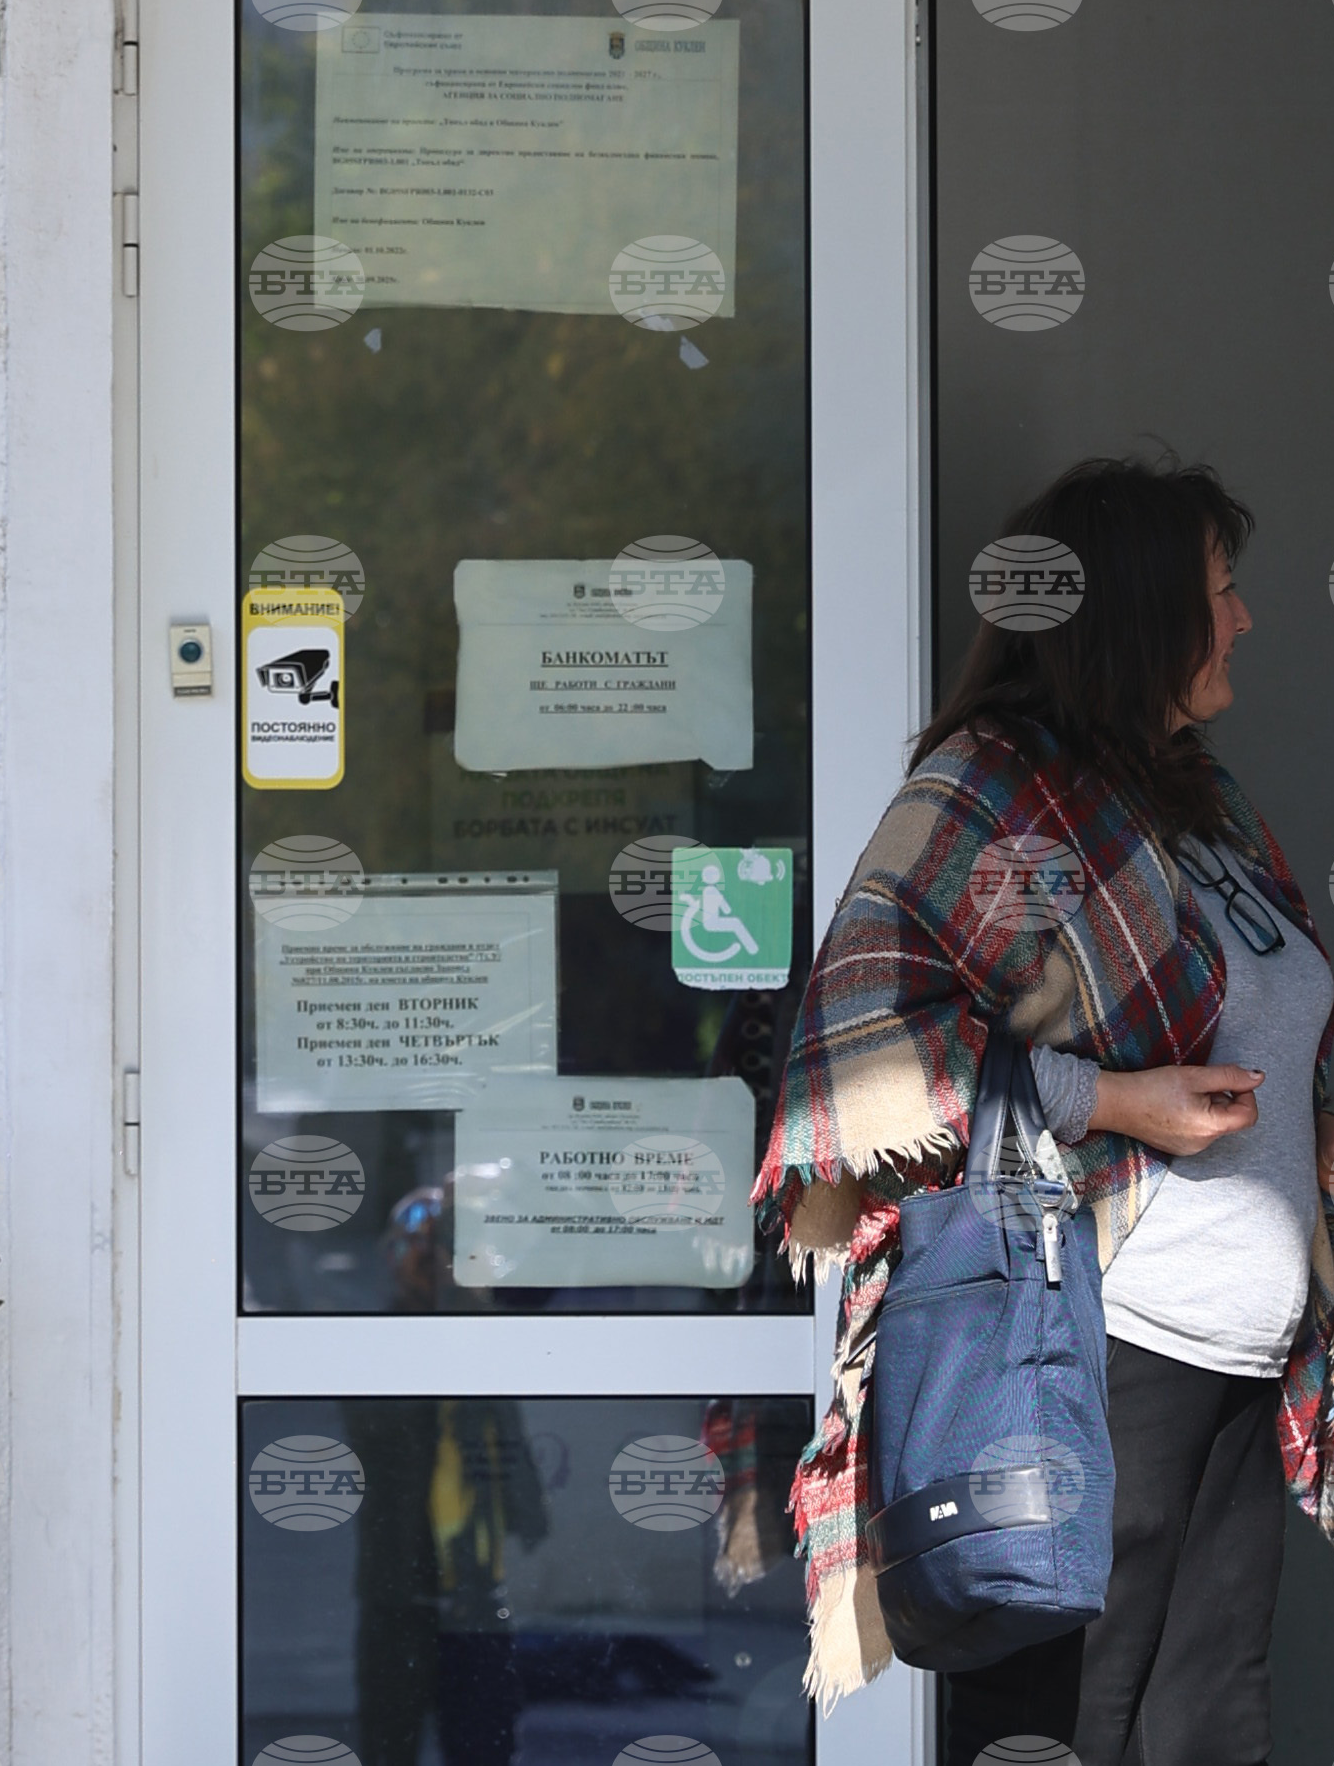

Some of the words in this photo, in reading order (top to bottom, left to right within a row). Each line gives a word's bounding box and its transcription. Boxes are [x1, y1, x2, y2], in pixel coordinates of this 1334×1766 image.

[541, 651, 669, 665] БАНКОМАТЪТ
[617, 681, 676, 690] ГРАЖДАНИ
[251, 722, 337, 734] ПОСТОЯННО
[297, 1000, 361, 1015] Приемен
[365, 1001, 390, 1013] ден
[398, 997, 479, 1011] ВТОРНИК
[316, 1020, 332, 1031] от
[336, 1017, 380, 1031] 8:30ч.
[383, 1020, 399, 1031] до
[297, 1037, 361, 1052] Приемен
[365, 1038, 390, 1050] ден
[398, 1034, 500, 1048] ЧЕТВЪРТЪК
[317, 1057, 332, 1068] от
[391, 1056, 408, 1068] до
[539, 1152, 625, 1166] РАБОТНО
[635, 1152, 696, 1166] ВРЕМЕ
